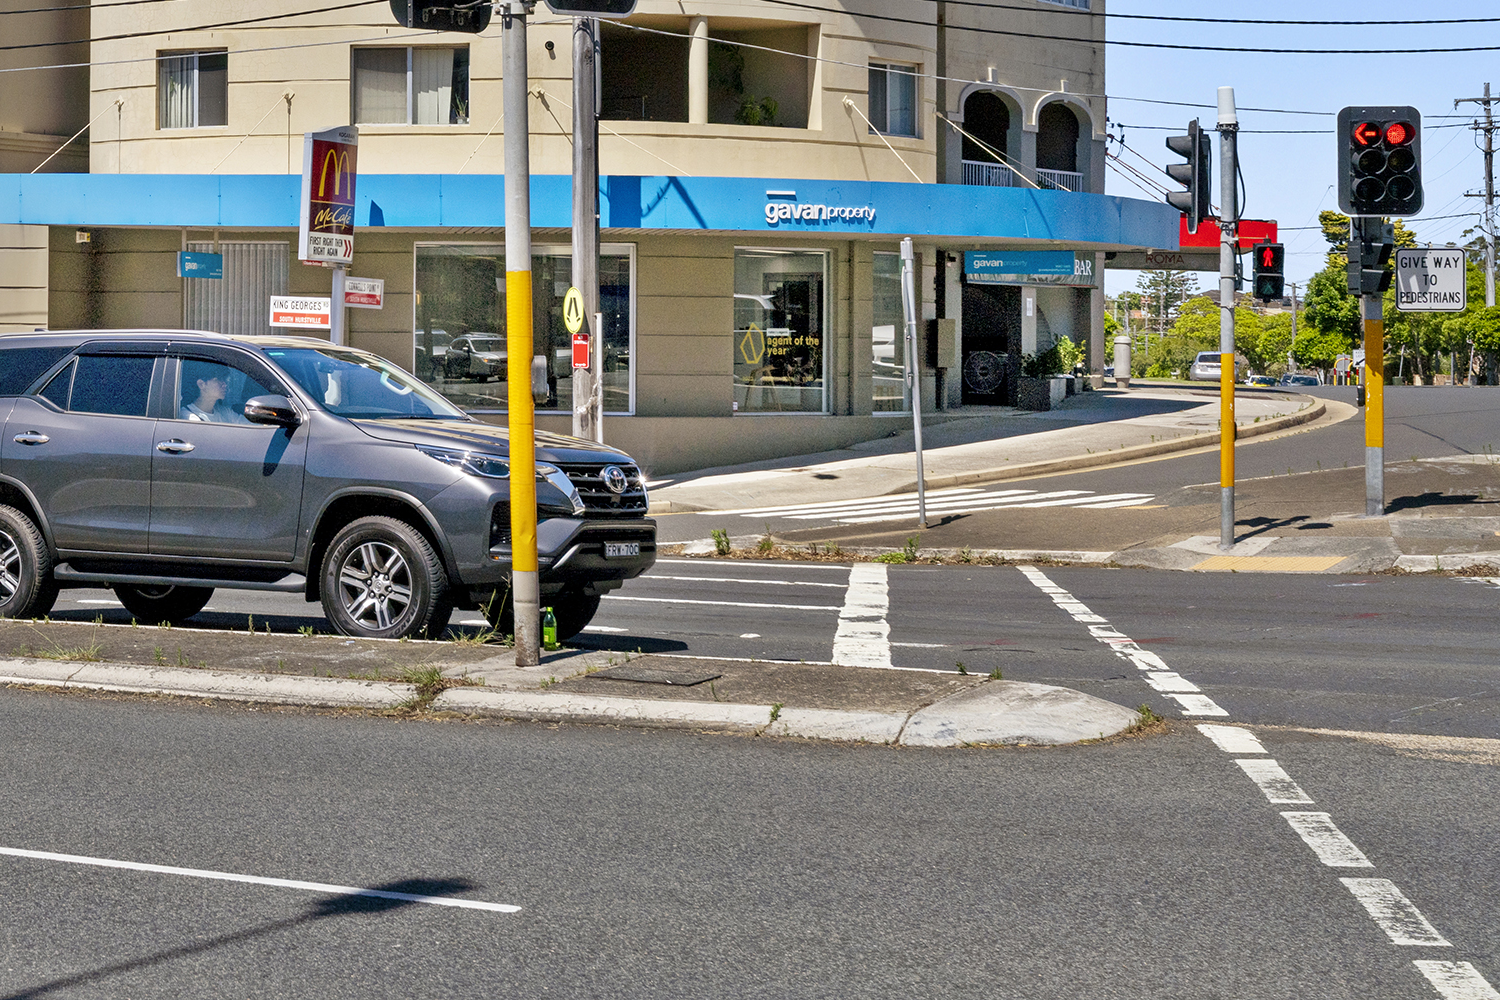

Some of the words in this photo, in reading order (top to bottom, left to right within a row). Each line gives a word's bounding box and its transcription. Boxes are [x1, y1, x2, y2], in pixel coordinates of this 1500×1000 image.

[314, 207, 352, 230] McCafé
[310, 236, 321, 245] FIRST
[322, 237, 334, 246] RIGHT
[313, 246, 325, 255] RIGHT
[327, 247, 338, 256] AGAIN
[1145, 253, 1185, 264] ROMA
[1400, 256, 1428, 268] GIVE
[1433, 256, 1460, 268] WAY
[1074, 259, 1092, 275] BAR
[1422, 273, 1438, 286] TO
[366, 283, 377, 293] POINT
[1400, 291, 1461, 304] PEDESTRIANS
[273, 300, 289, 310] KING
[290, 301, 322, 311] GEORGES
[279, 315, 294, 323] SOUTH
[295, 316, 322, 324] HURSTVILLE
[767, 337, 792, 347] agent
[794, 335, 804, 345] of
[805, 335, 820, 345] the
[767, 347, 787, 357] year
